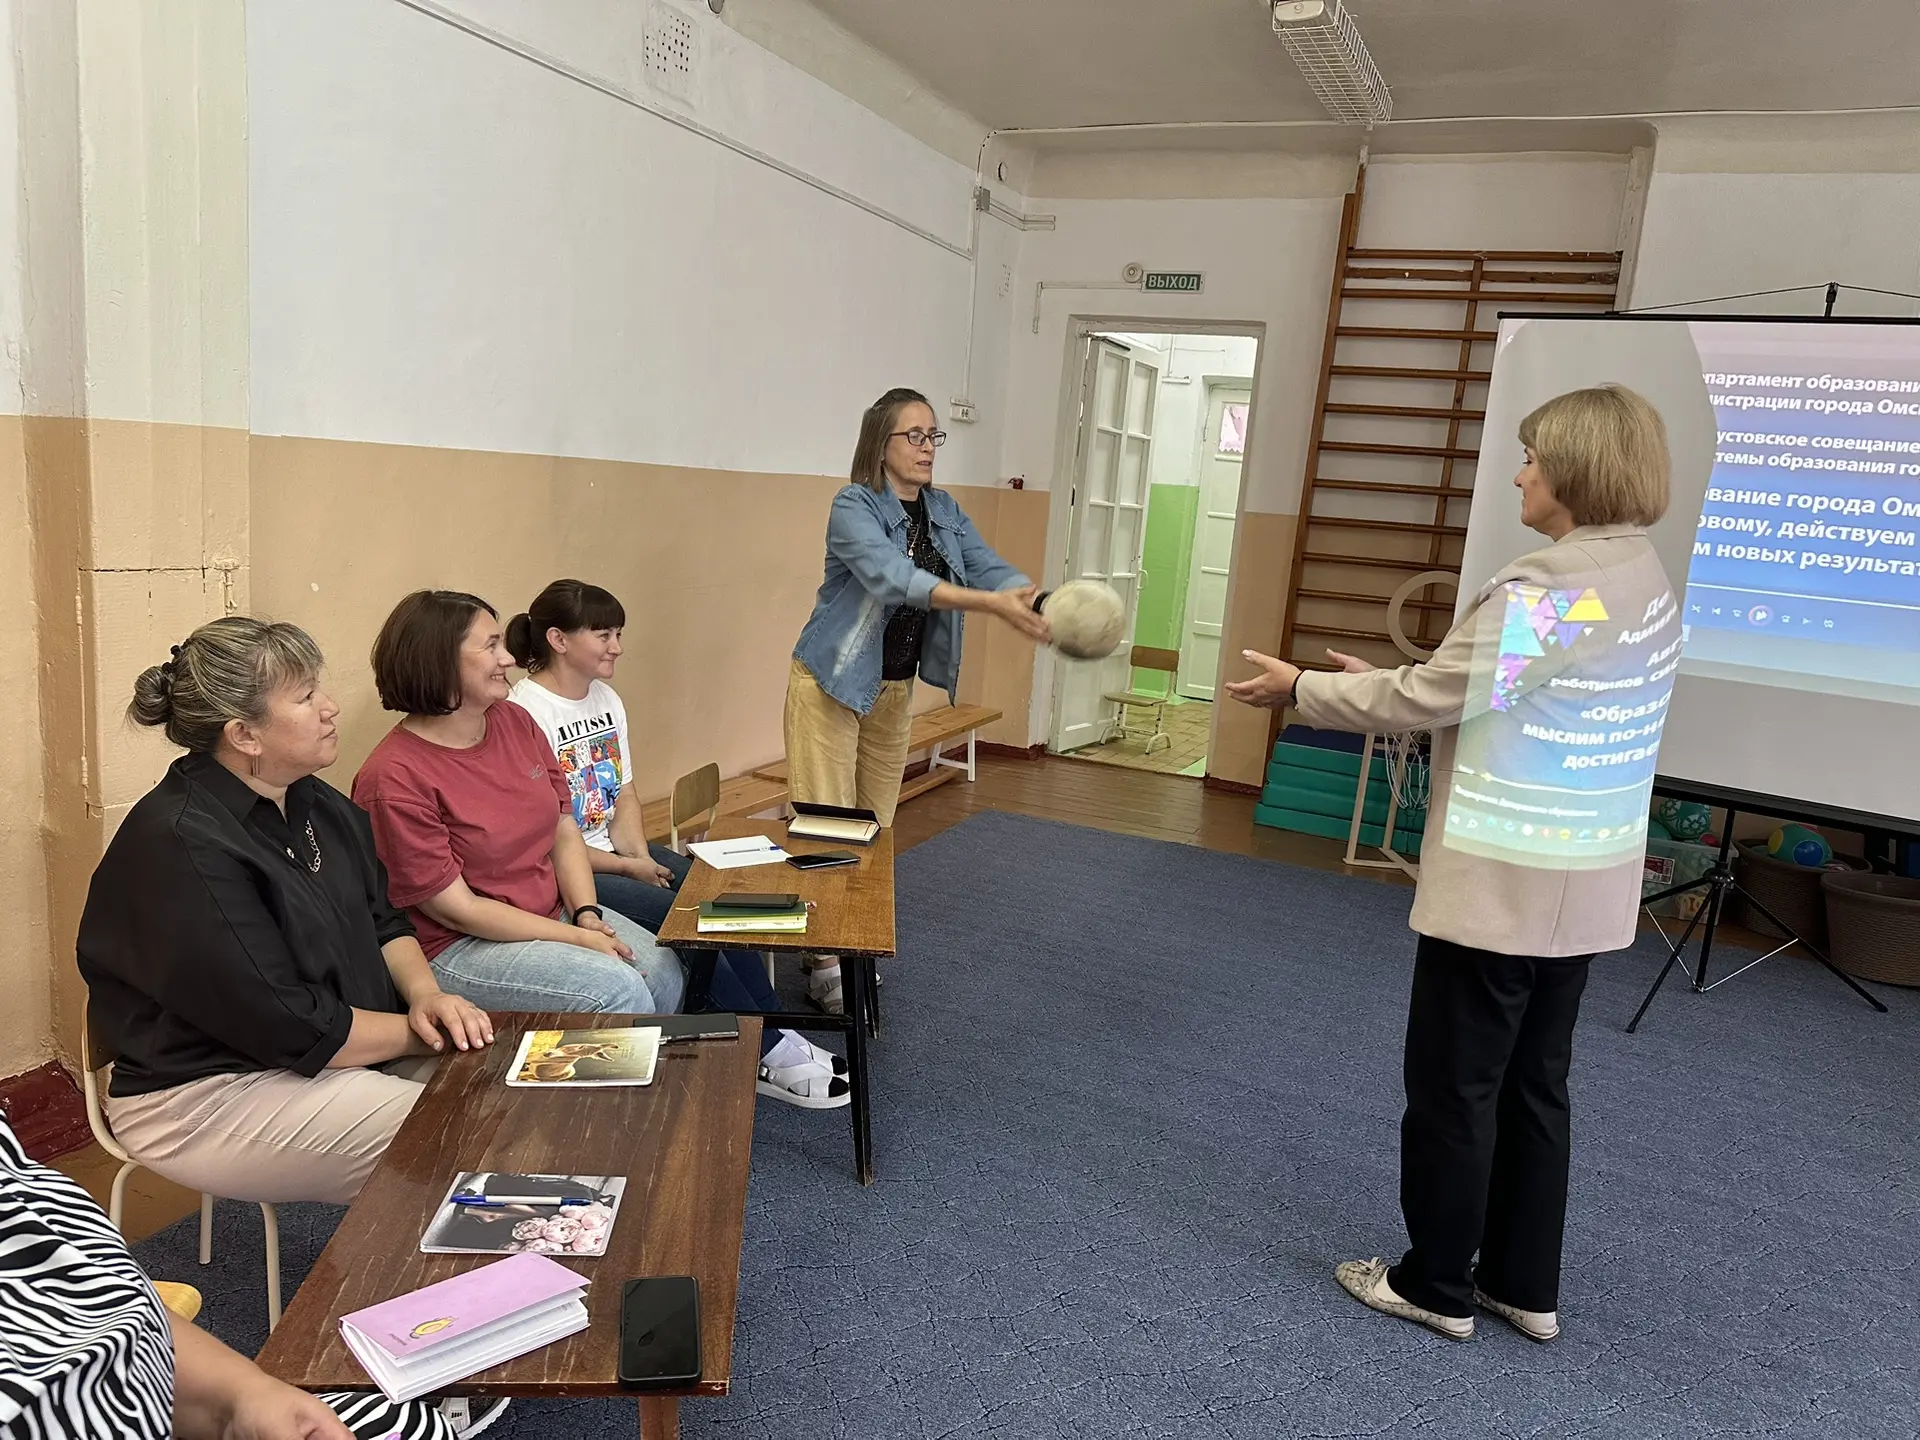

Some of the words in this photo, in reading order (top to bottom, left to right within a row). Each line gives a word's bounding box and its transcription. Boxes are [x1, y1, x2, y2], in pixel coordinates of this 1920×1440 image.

[1148, 275, 1198, 290] ВЫХОД
[1703, 373, 1804, 388] партамент
[1804, 398, 1874, 415] города
[1877, 399, 1920, 416] Омс
[1716, 431, 1808, 447] устовское
[1811, 436, 1920, 453] совещание
[1713, 452, 1764, 465] темы
[1767, 453, 1896, 474] образования
[1704, 488, 1782, 506] вание
[1786, 494, 1876, 516] города
[1777, 519, 1915, 547] действуем
[1692, 542, 1711, 556] м
[1716, 543, 1796, 565] новых
[1522, 723, 1605, 745] мыслим
